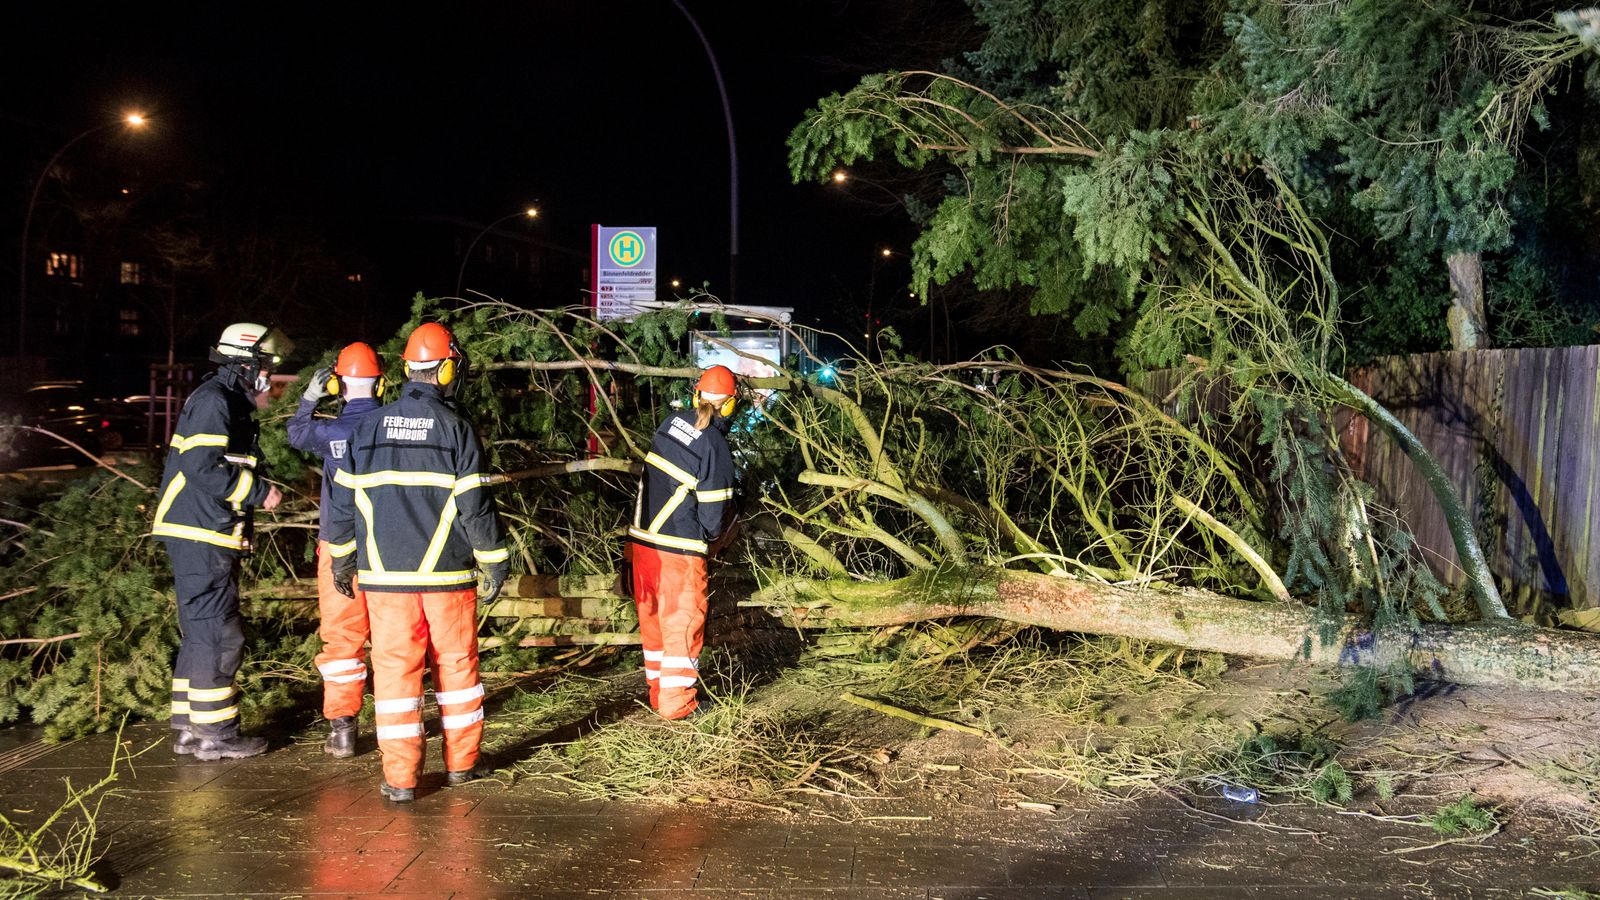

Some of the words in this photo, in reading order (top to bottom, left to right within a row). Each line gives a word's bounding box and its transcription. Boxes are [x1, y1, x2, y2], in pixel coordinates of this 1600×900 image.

[619, 240, 635, 257] H
[383, 416, 434, 429] FEUERWEHR
[386, 427, 428, 440] HAMBURG
